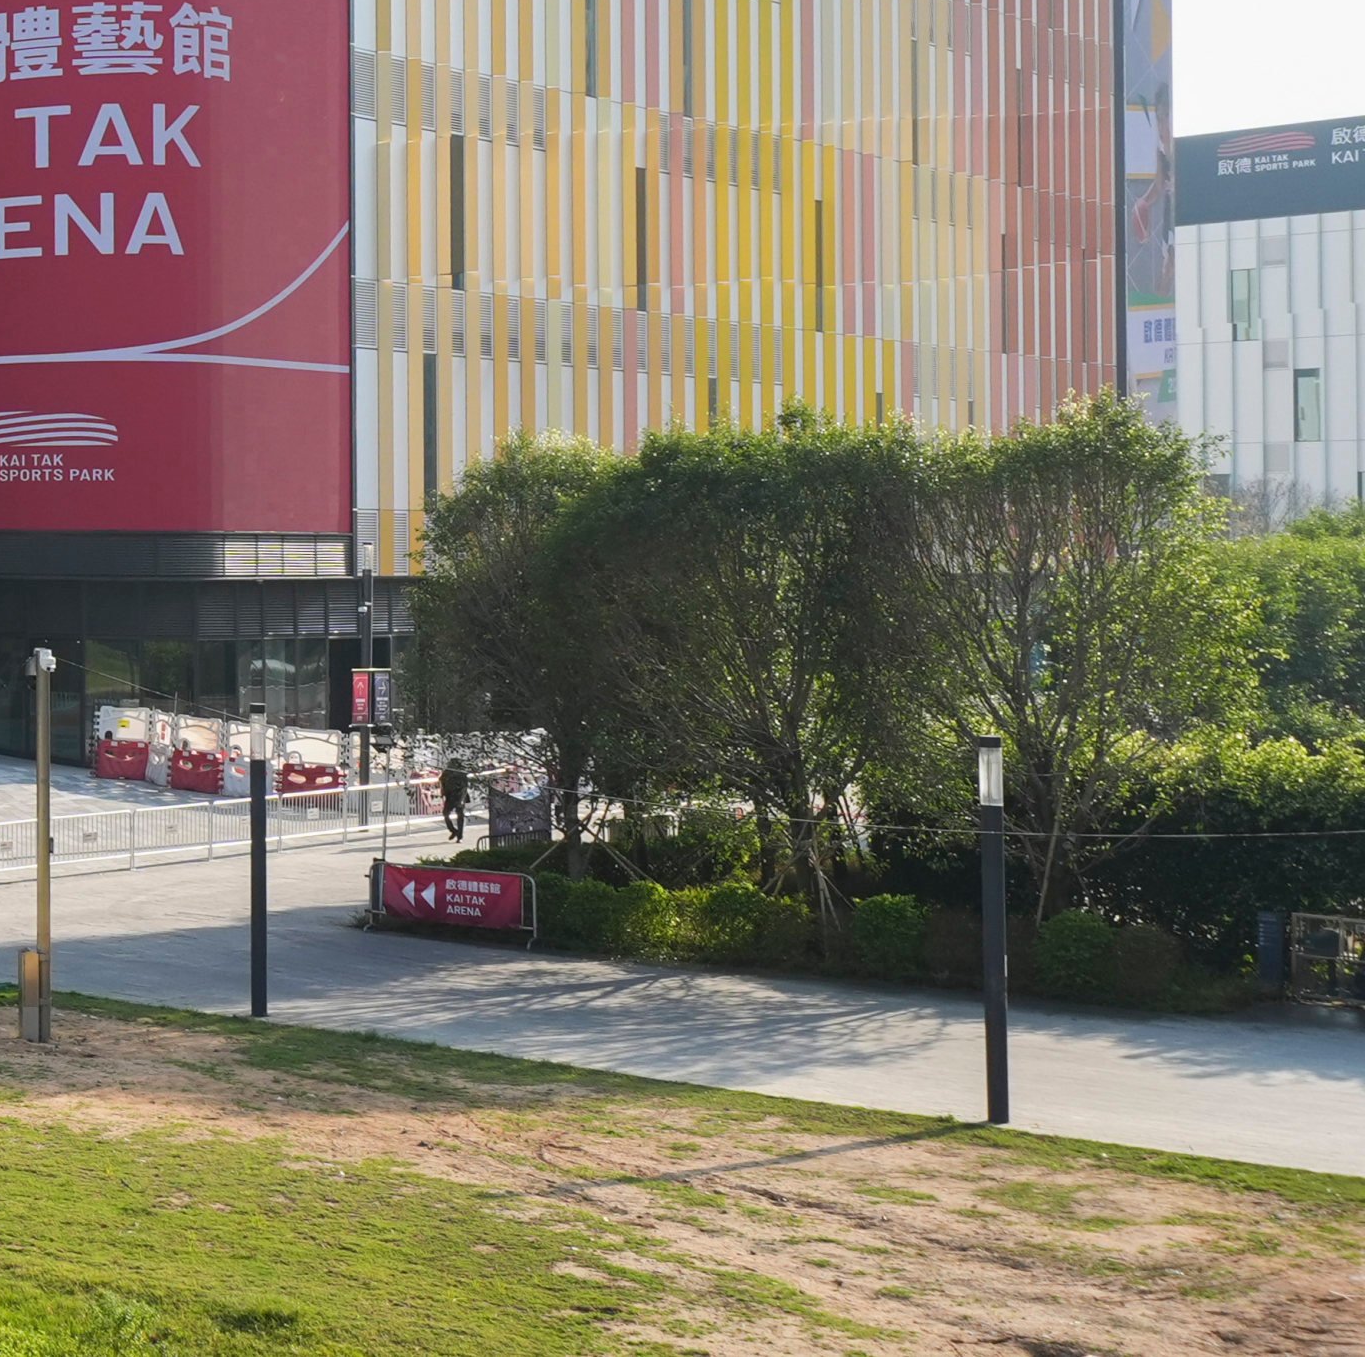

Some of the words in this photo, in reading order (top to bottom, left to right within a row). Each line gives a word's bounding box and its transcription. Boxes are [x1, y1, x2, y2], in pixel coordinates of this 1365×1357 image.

[14, 102, 201, 169] TAK
[1254, 155, 1269, 164] KAI
[1271, 154, 1289, 162] TAK
[1331, 149, 1359, 164] KAI
[1217, 157, 1252, 176] 啟德
[1254, 161, 1289, 172] SPORTS
[1292, 159, 1316, 168] PARK
[0, 454, 25, 467] KAI
[31, 453, 63, 467] TAK
[0, 468, 64, 482] SPORTS
[69, 468, 115, 481] PARK
[446, 893, 463, 903] KAI
[466, 895, 485, 906] TAK
[446, 905, 482, 917] ARENA
